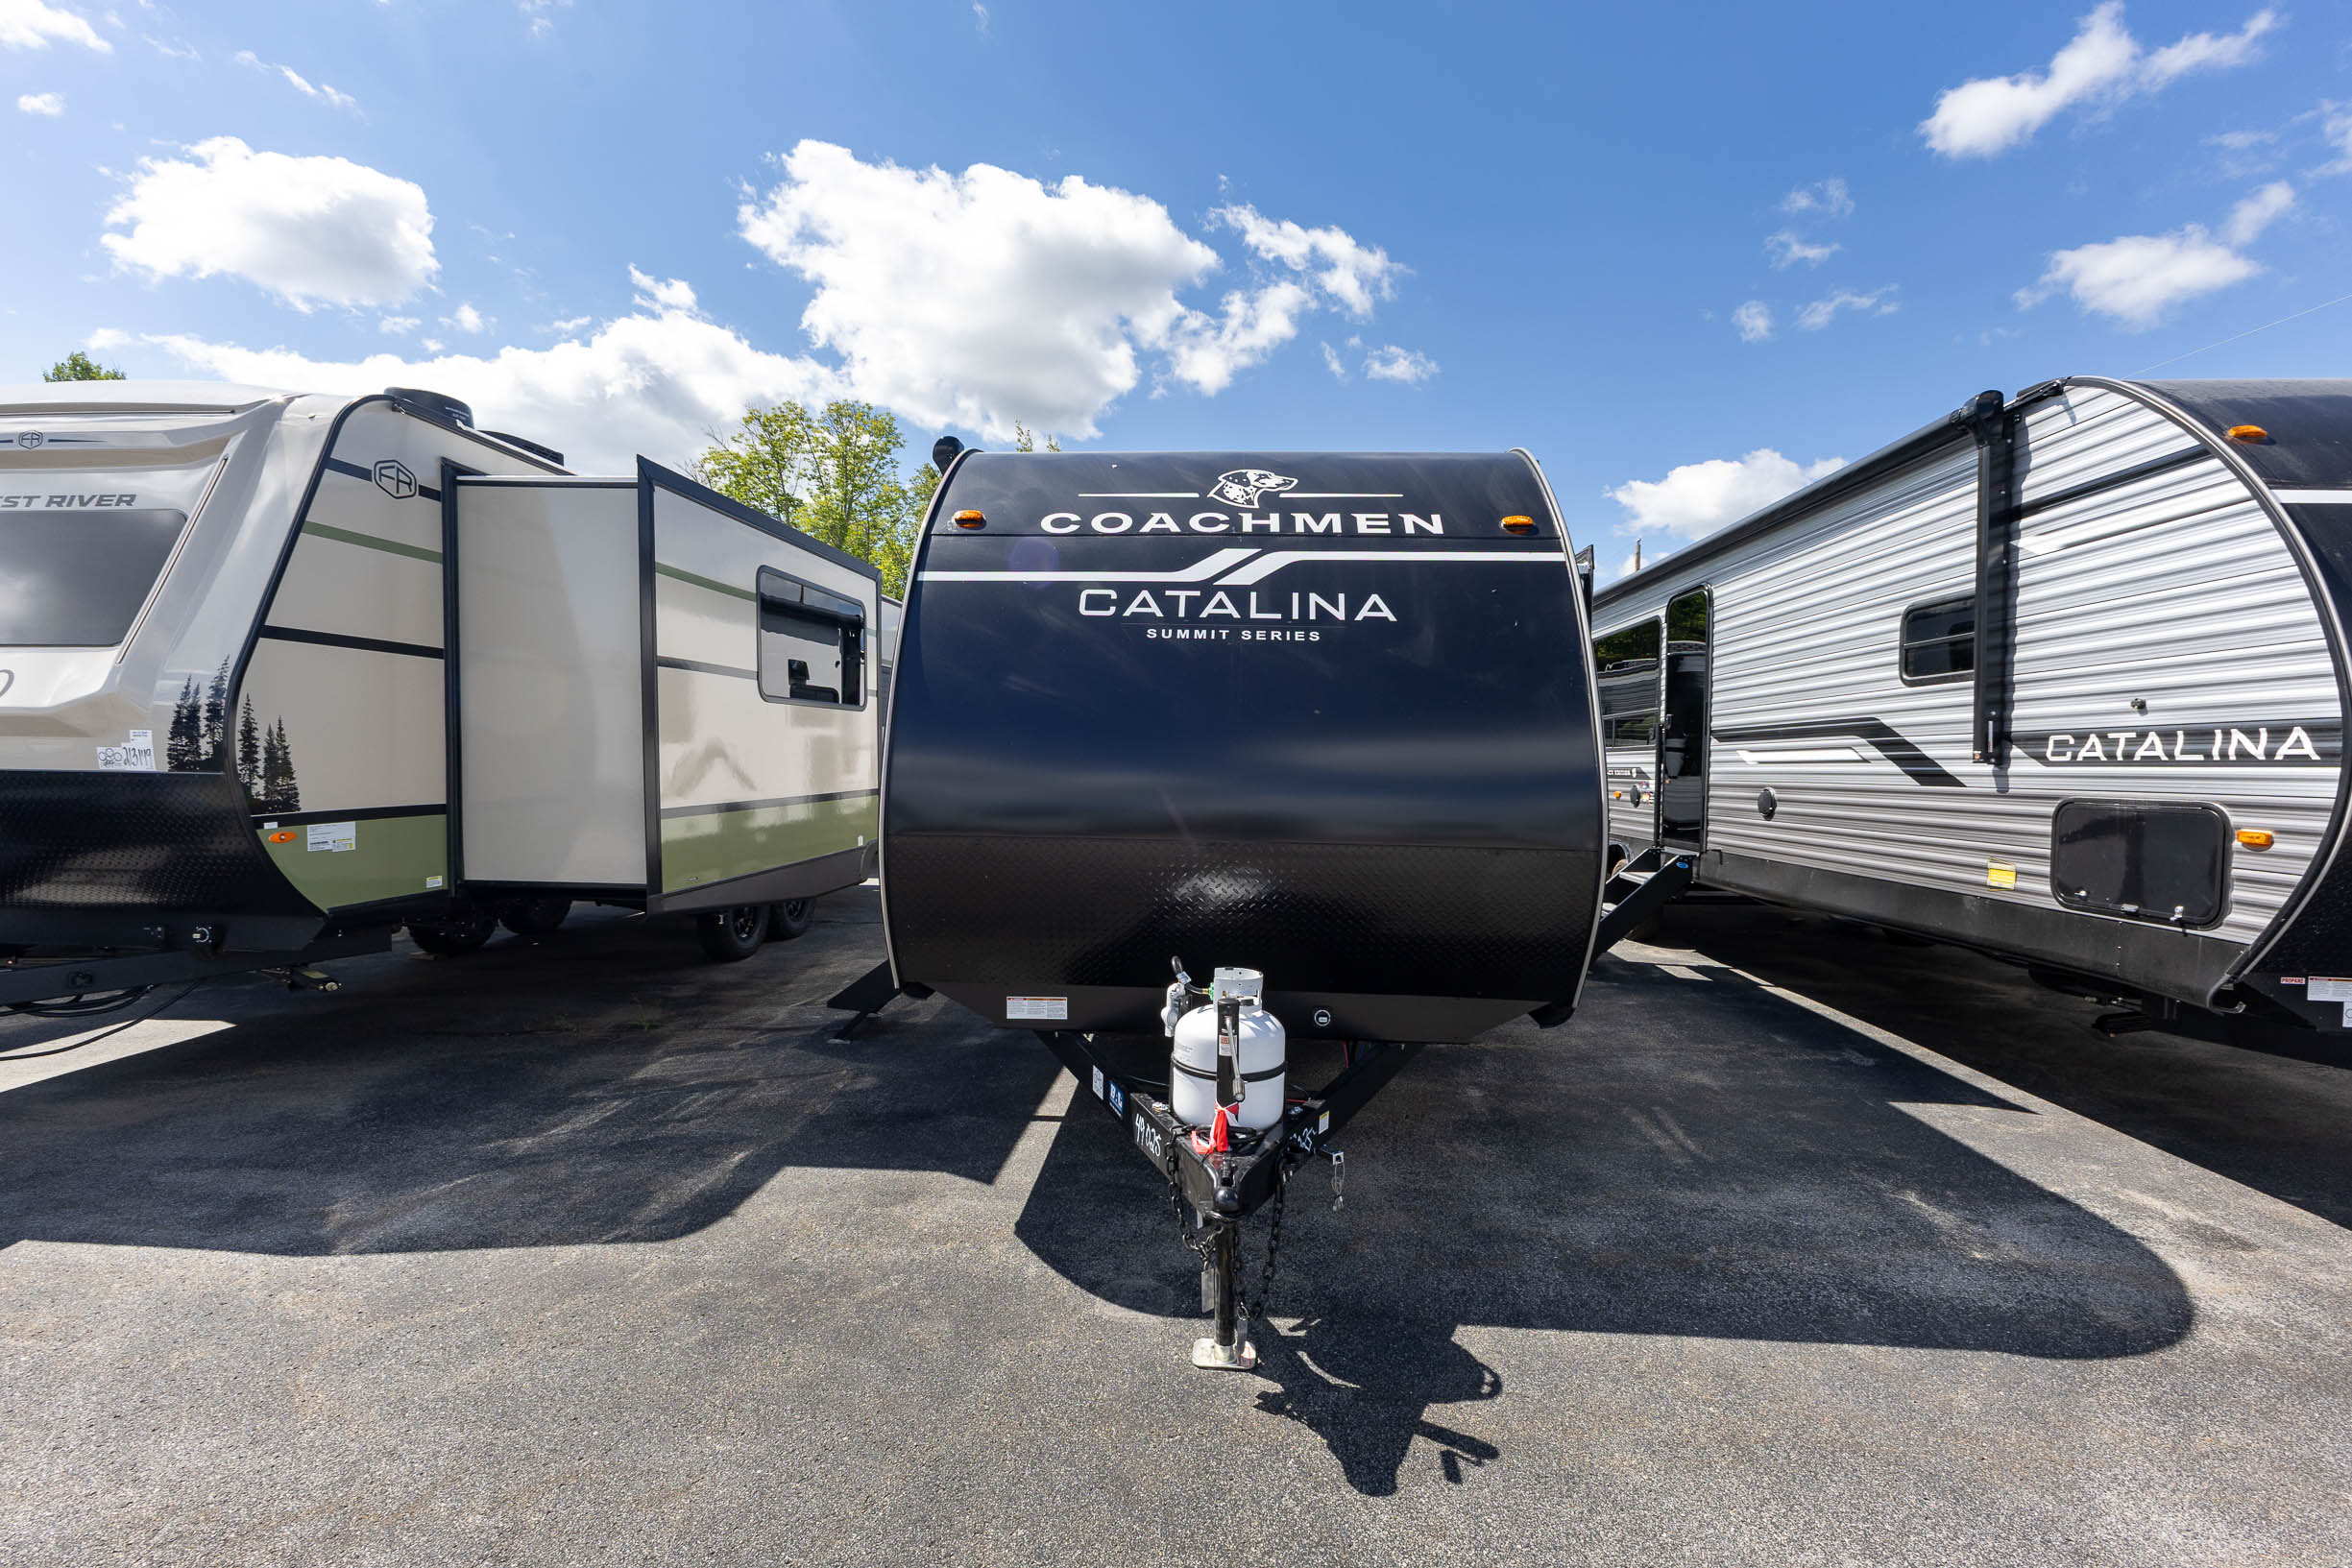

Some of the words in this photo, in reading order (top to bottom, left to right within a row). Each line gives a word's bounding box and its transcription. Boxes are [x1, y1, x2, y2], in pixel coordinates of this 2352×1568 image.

[0, 495, 41, 508] ST
[45, 494, 137, 508] RIVER
[1040, 512, 1444, 535] COACHMEN
[1079, 589, 1398, 622] CATALINA
[1146, 628, 1230, 640] SUMMIT
[1241, 630, 1321, 641] SERIES
[2045, 726, 2322, 762] CATALINA
